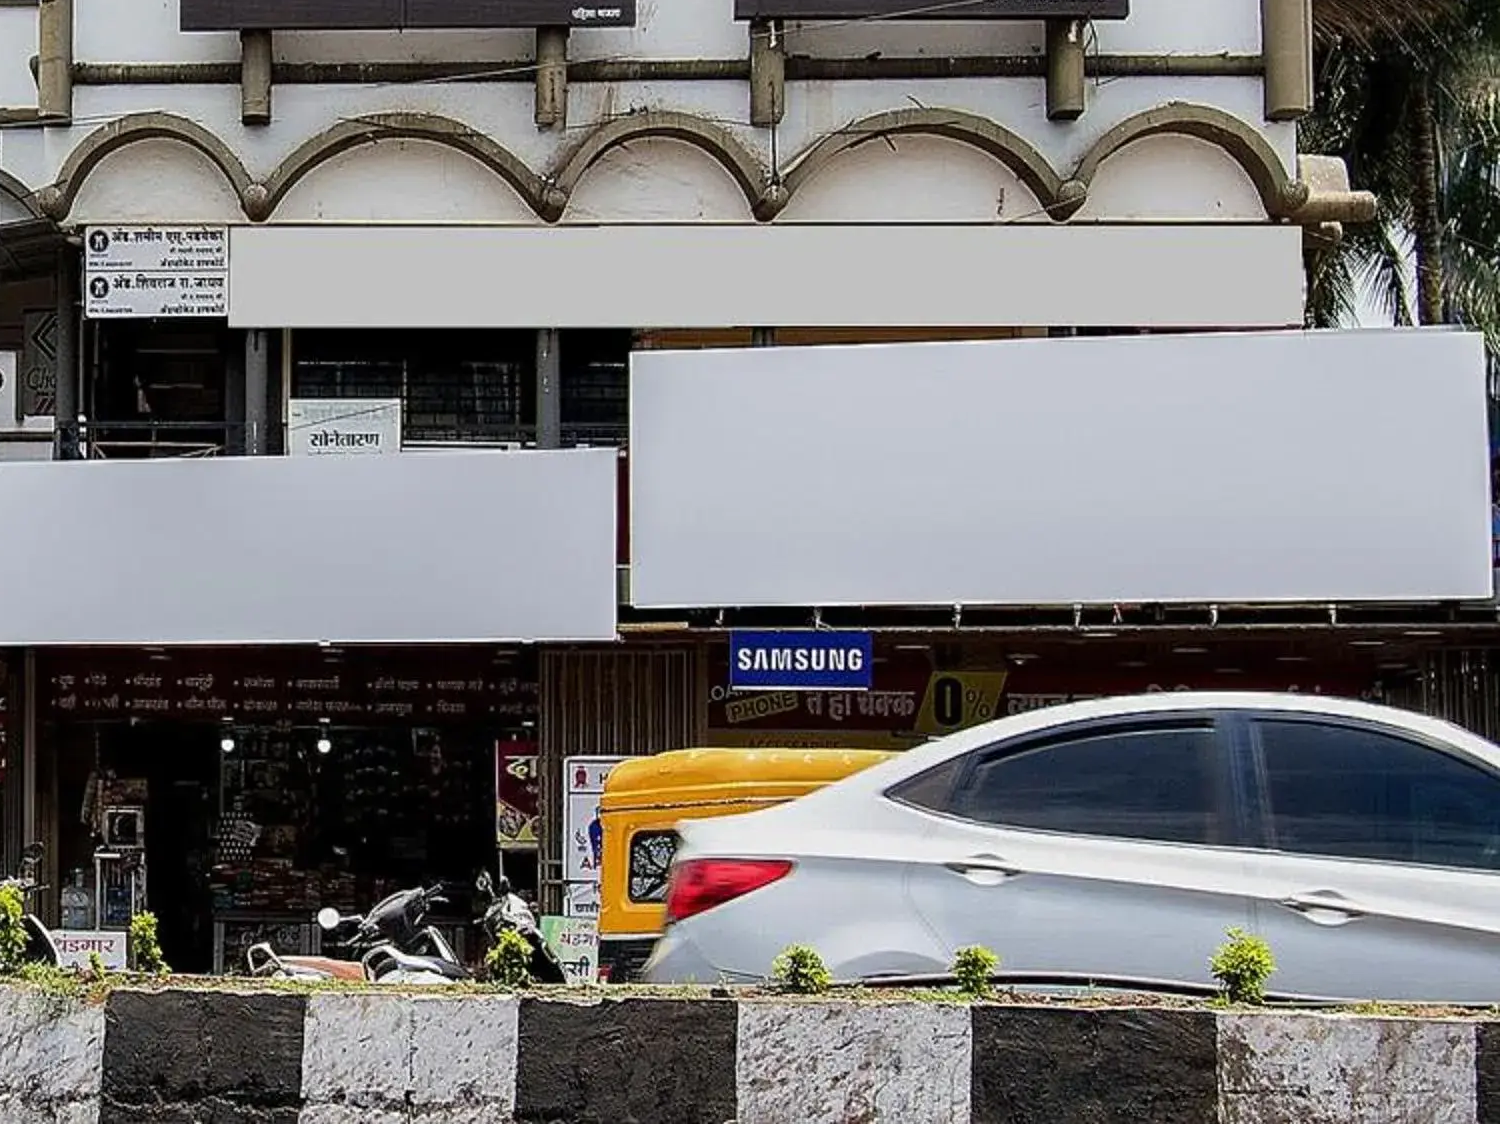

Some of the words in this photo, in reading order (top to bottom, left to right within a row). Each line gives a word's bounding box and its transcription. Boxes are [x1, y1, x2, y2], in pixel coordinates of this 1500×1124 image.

[310, 429, 380, 447] सोनेतारण
[737, 648, 863, 671] SAMSUNG
[731, 691, 798, 719] PHONE
